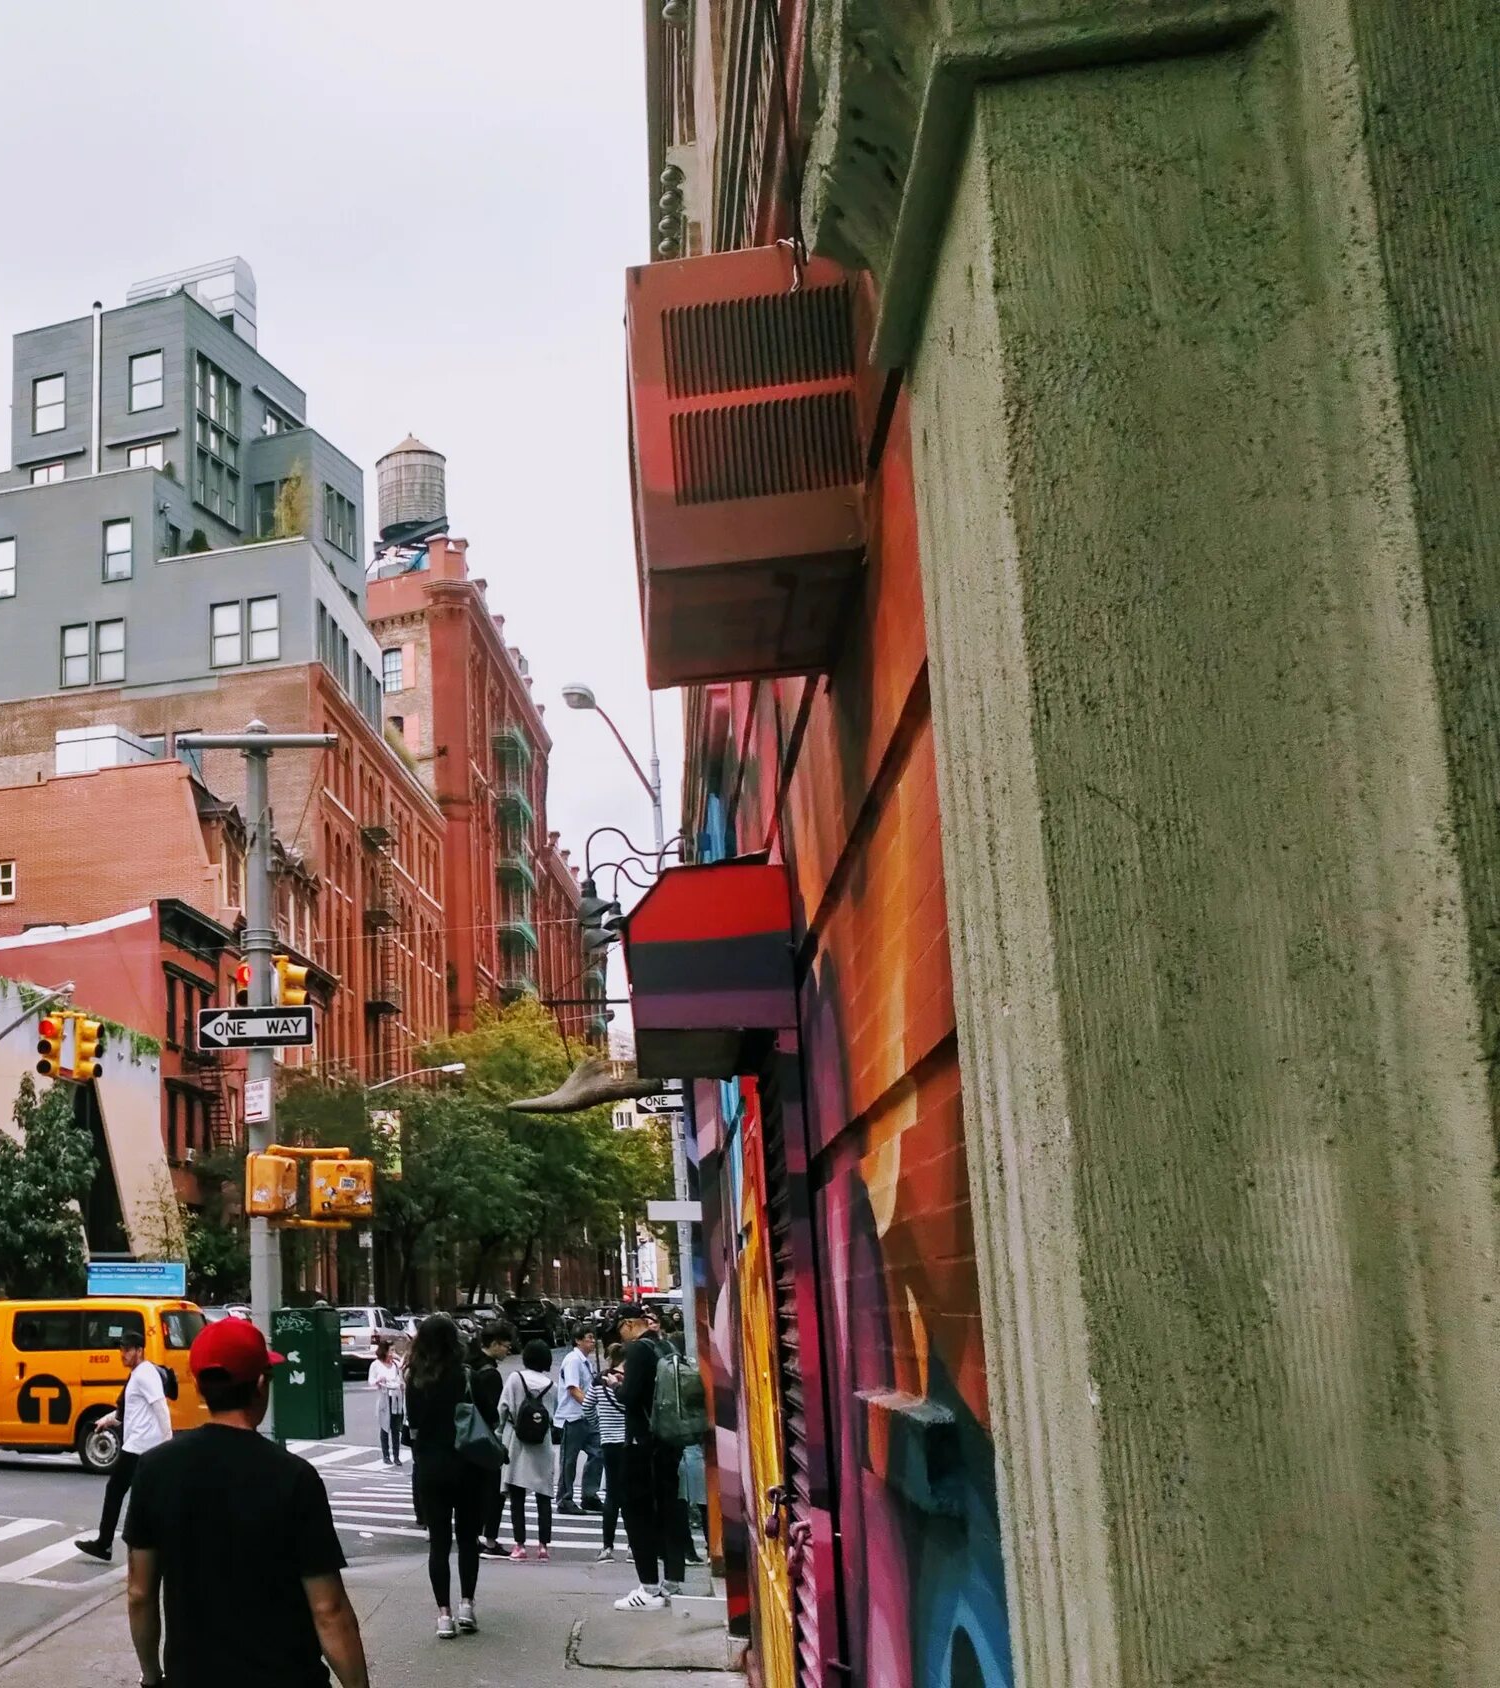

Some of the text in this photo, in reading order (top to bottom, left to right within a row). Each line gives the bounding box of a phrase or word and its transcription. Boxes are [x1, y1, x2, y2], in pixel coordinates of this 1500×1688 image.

[213, 1018, 302, 1037] ONE WAY
[645, 1096, 668, 1107] ONE
[29, 1386, 60, 1425] T
